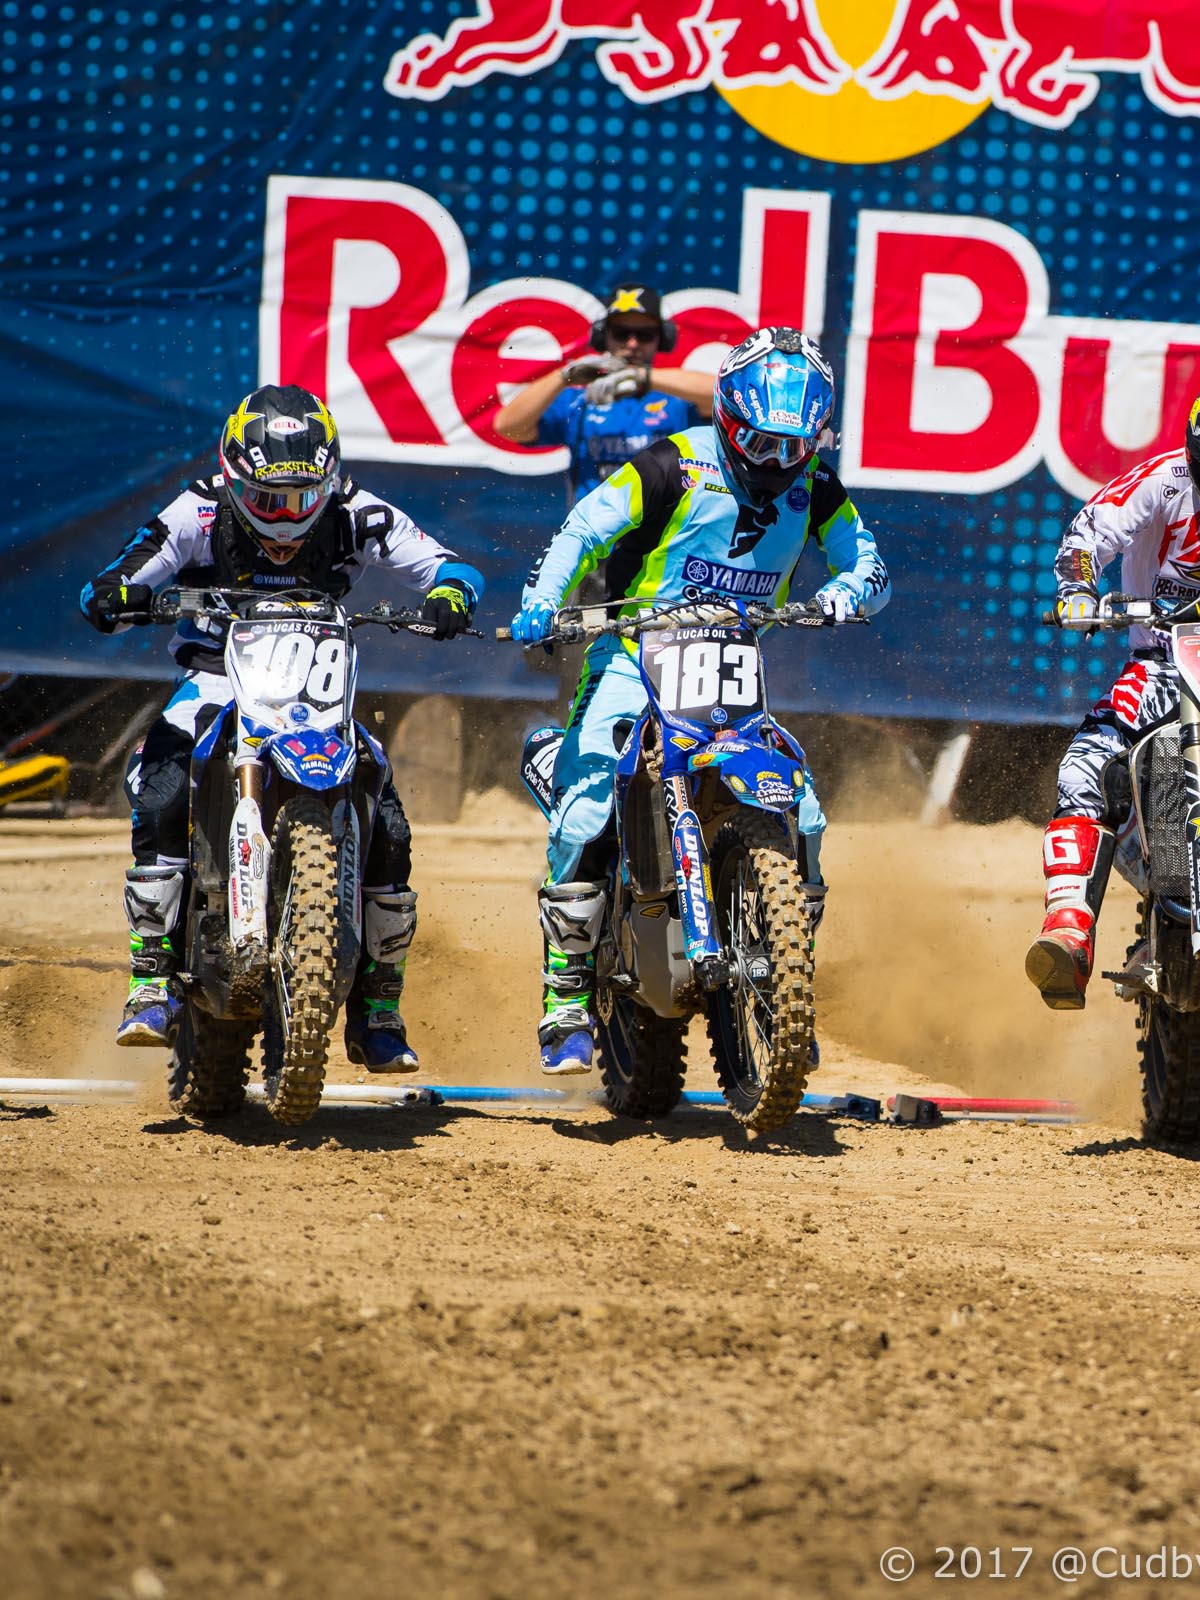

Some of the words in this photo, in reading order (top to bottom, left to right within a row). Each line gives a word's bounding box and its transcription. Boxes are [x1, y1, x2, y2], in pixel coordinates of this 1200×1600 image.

[260, 176, 830, 475] Red
[274, 421, 299, 430] BELL
[264, 575, 297, 586] YAMAHA
[711, 565, 777, 594] YAMAHA
[267, 623, 302, 633] LUCAS
[303, 624, 320, 634] OIL
[676, 629, 710, 640] LUCAS
[711, 629, 728, 639] OIL
[242, 632, 345, 702] 108
[653, 642, 758, 711] 183
[300, 760, 334, 772] YAMAHA
[758, 780, 789, 791] Cycle
[535, 778, 552, 806] Trade
[758, 795, 795, 805] YAMAHA
[236, 821, 254, 911] DULOP
[751, 967, 768, 978] 183
